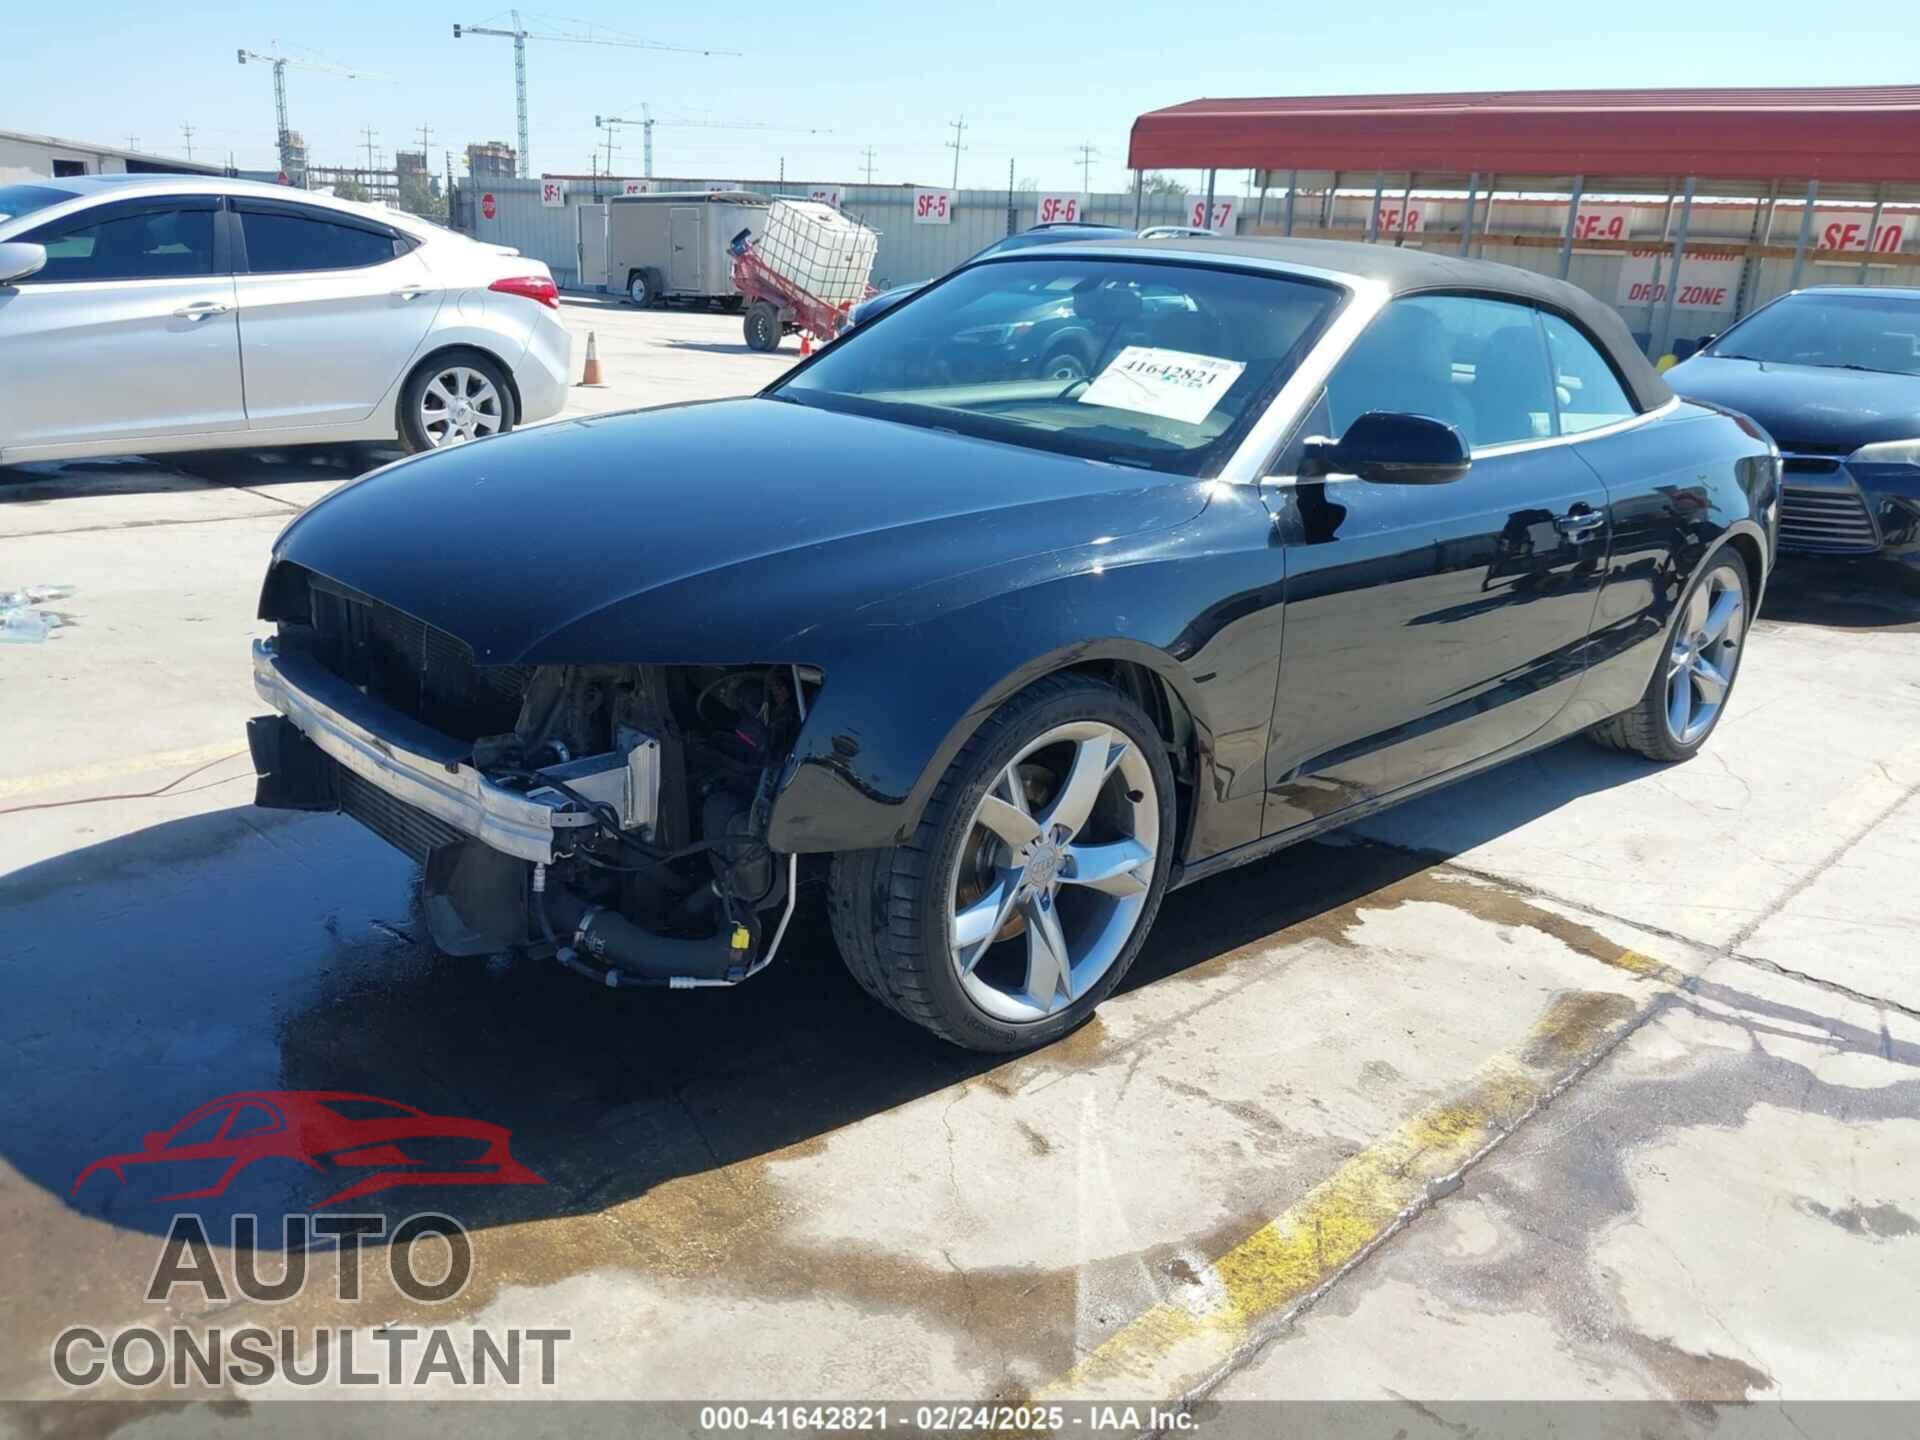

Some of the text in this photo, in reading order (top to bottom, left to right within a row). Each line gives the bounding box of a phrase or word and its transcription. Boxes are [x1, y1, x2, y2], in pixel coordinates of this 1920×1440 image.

[544, 184, 561, 202] SF-1
[917, 194, 945, 218] SF-5
[1042, 198, 1076, 222] SF-6
[1192, 202, 1232, 228] S-7
[1628, 282, 1727, 305] DRO ZONE
[1124, 360, 1218, 385] 41642821
